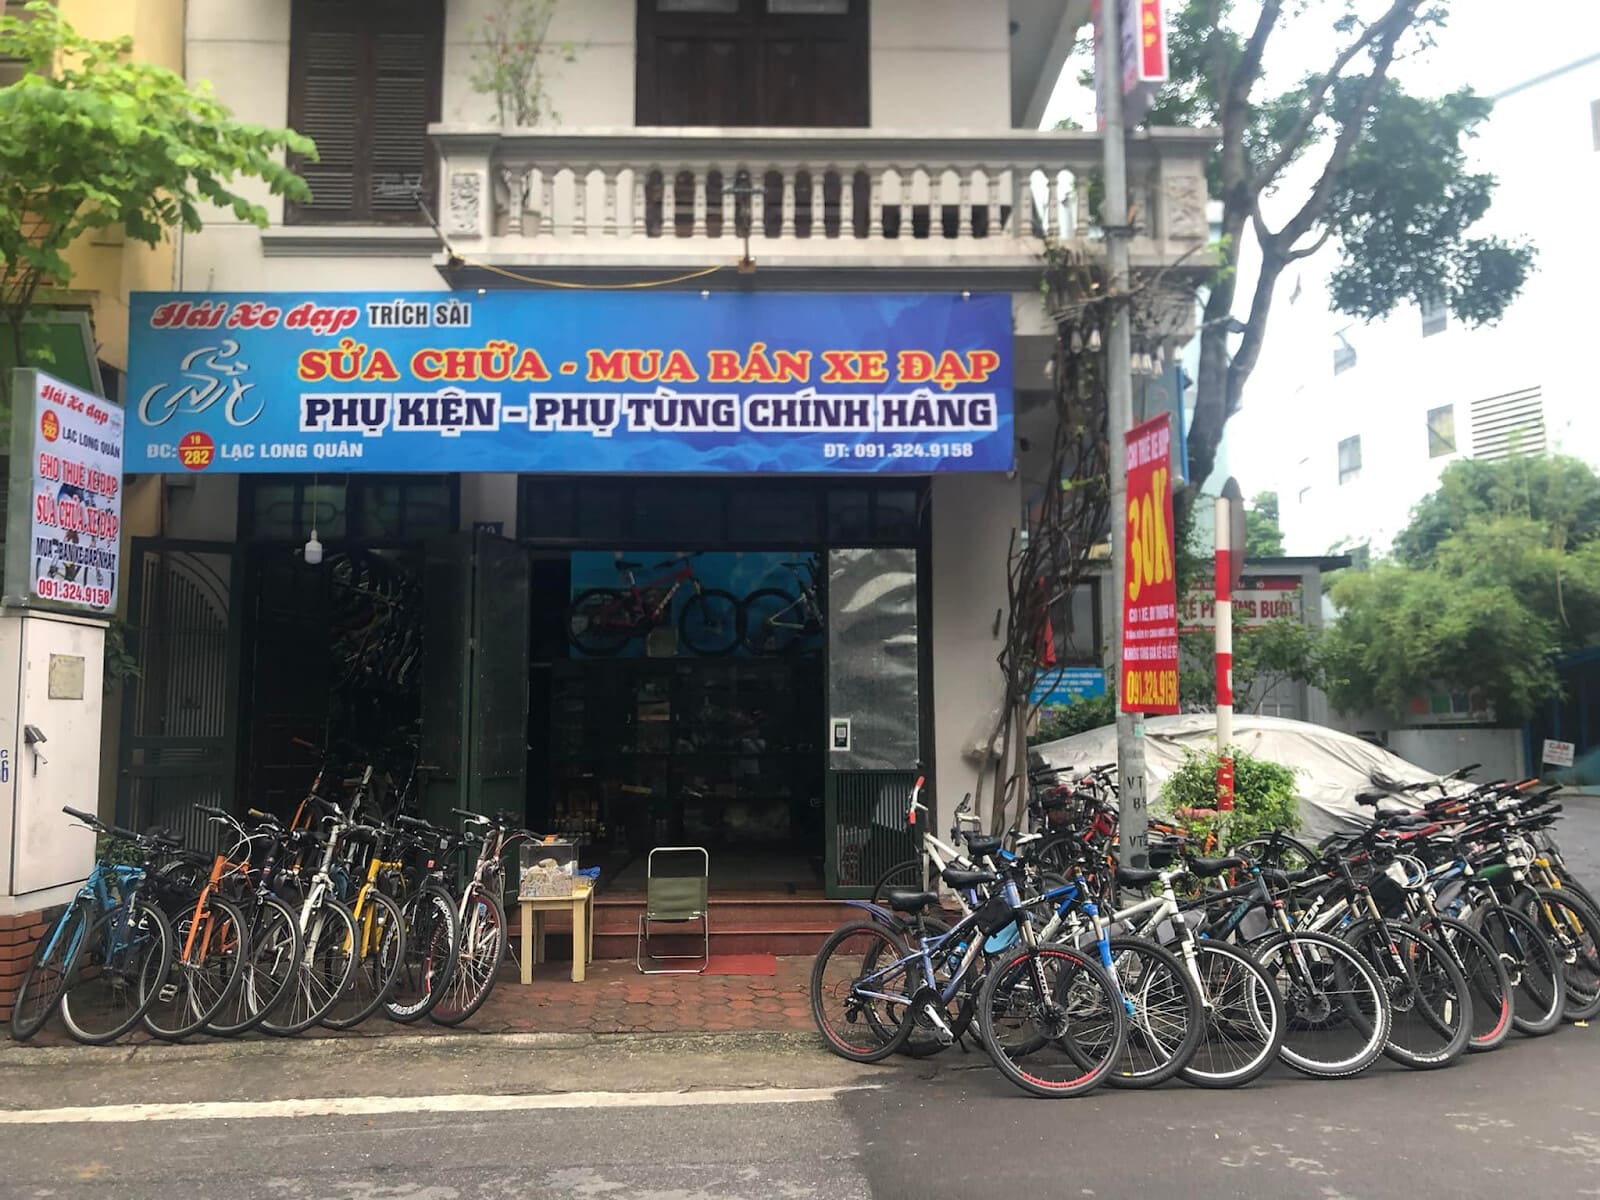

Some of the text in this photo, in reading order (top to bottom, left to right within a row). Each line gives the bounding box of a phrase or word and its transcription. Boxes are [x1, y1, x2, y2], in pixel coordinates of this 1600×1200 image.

[227, 303, 280, 327] Xe
[368, 301, 428, 325] TRÍCH
[300, 338, 400, 380] SỬA
[411, 340, 550, 381] CHỮA
[587, 350, 698, 381] MUA
[708, 343, 811, 382] BÁN
[822, 350, 888, 382] XE
[898, 350, 999, 390] ĐẠP
[305, 398, 387, 432] PHỤ
[398, 391, 496, 432] KIỆN
[535, 398, 616, 432] PHỤ
[627, 392, 735, 427] TÙNG
[748, 393, 870, 427] CHÍNH
[147, 444, 177, 458] ĐC:
[184, 450, 209, 465] 282
[221, 444, 254, 461] LẠC
[260, 444, 307, 458] LONG
[313, 440, 363, 459] QUÂN
[824, 443, 973, 458] ĐT: 091.324.9158
[39, 452, 59, 481] CHO
[1129, 467, 1172, 601] 30K
[38, 578, 110, 605] 091.324.9158
